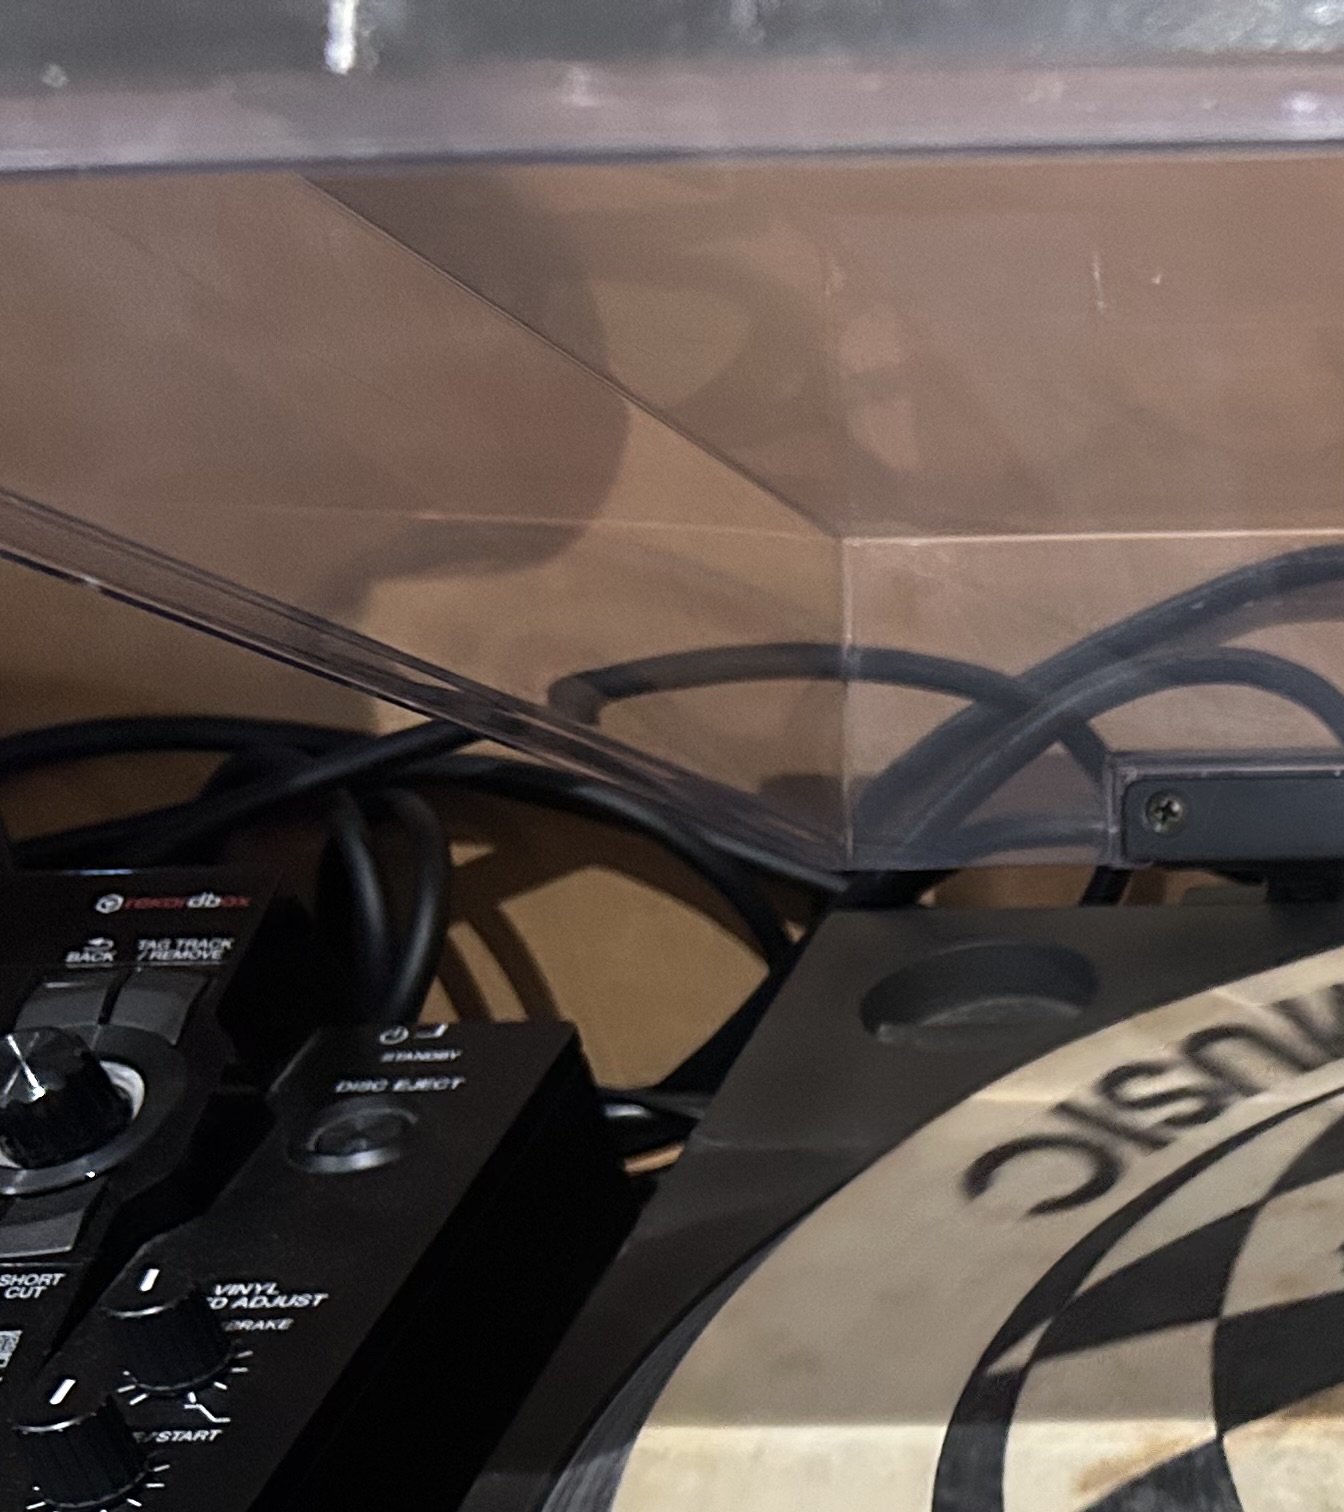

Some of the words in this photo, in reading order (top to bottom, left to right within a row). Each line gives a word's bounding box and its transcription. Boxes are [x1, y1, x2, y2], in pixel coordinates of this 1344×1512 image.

[174, 938, 235, 950] TRACK
[65, 951, 116, 963] BACK
[392, 1076, 466, 1092] EJECT
[0, 1273, 65, 1287] SHORT
[4, 1286, 47, 1299] CUT
[213, 1283, 280, 1296] VINYL
[231, 1293, 328, 1309] ADJUST
